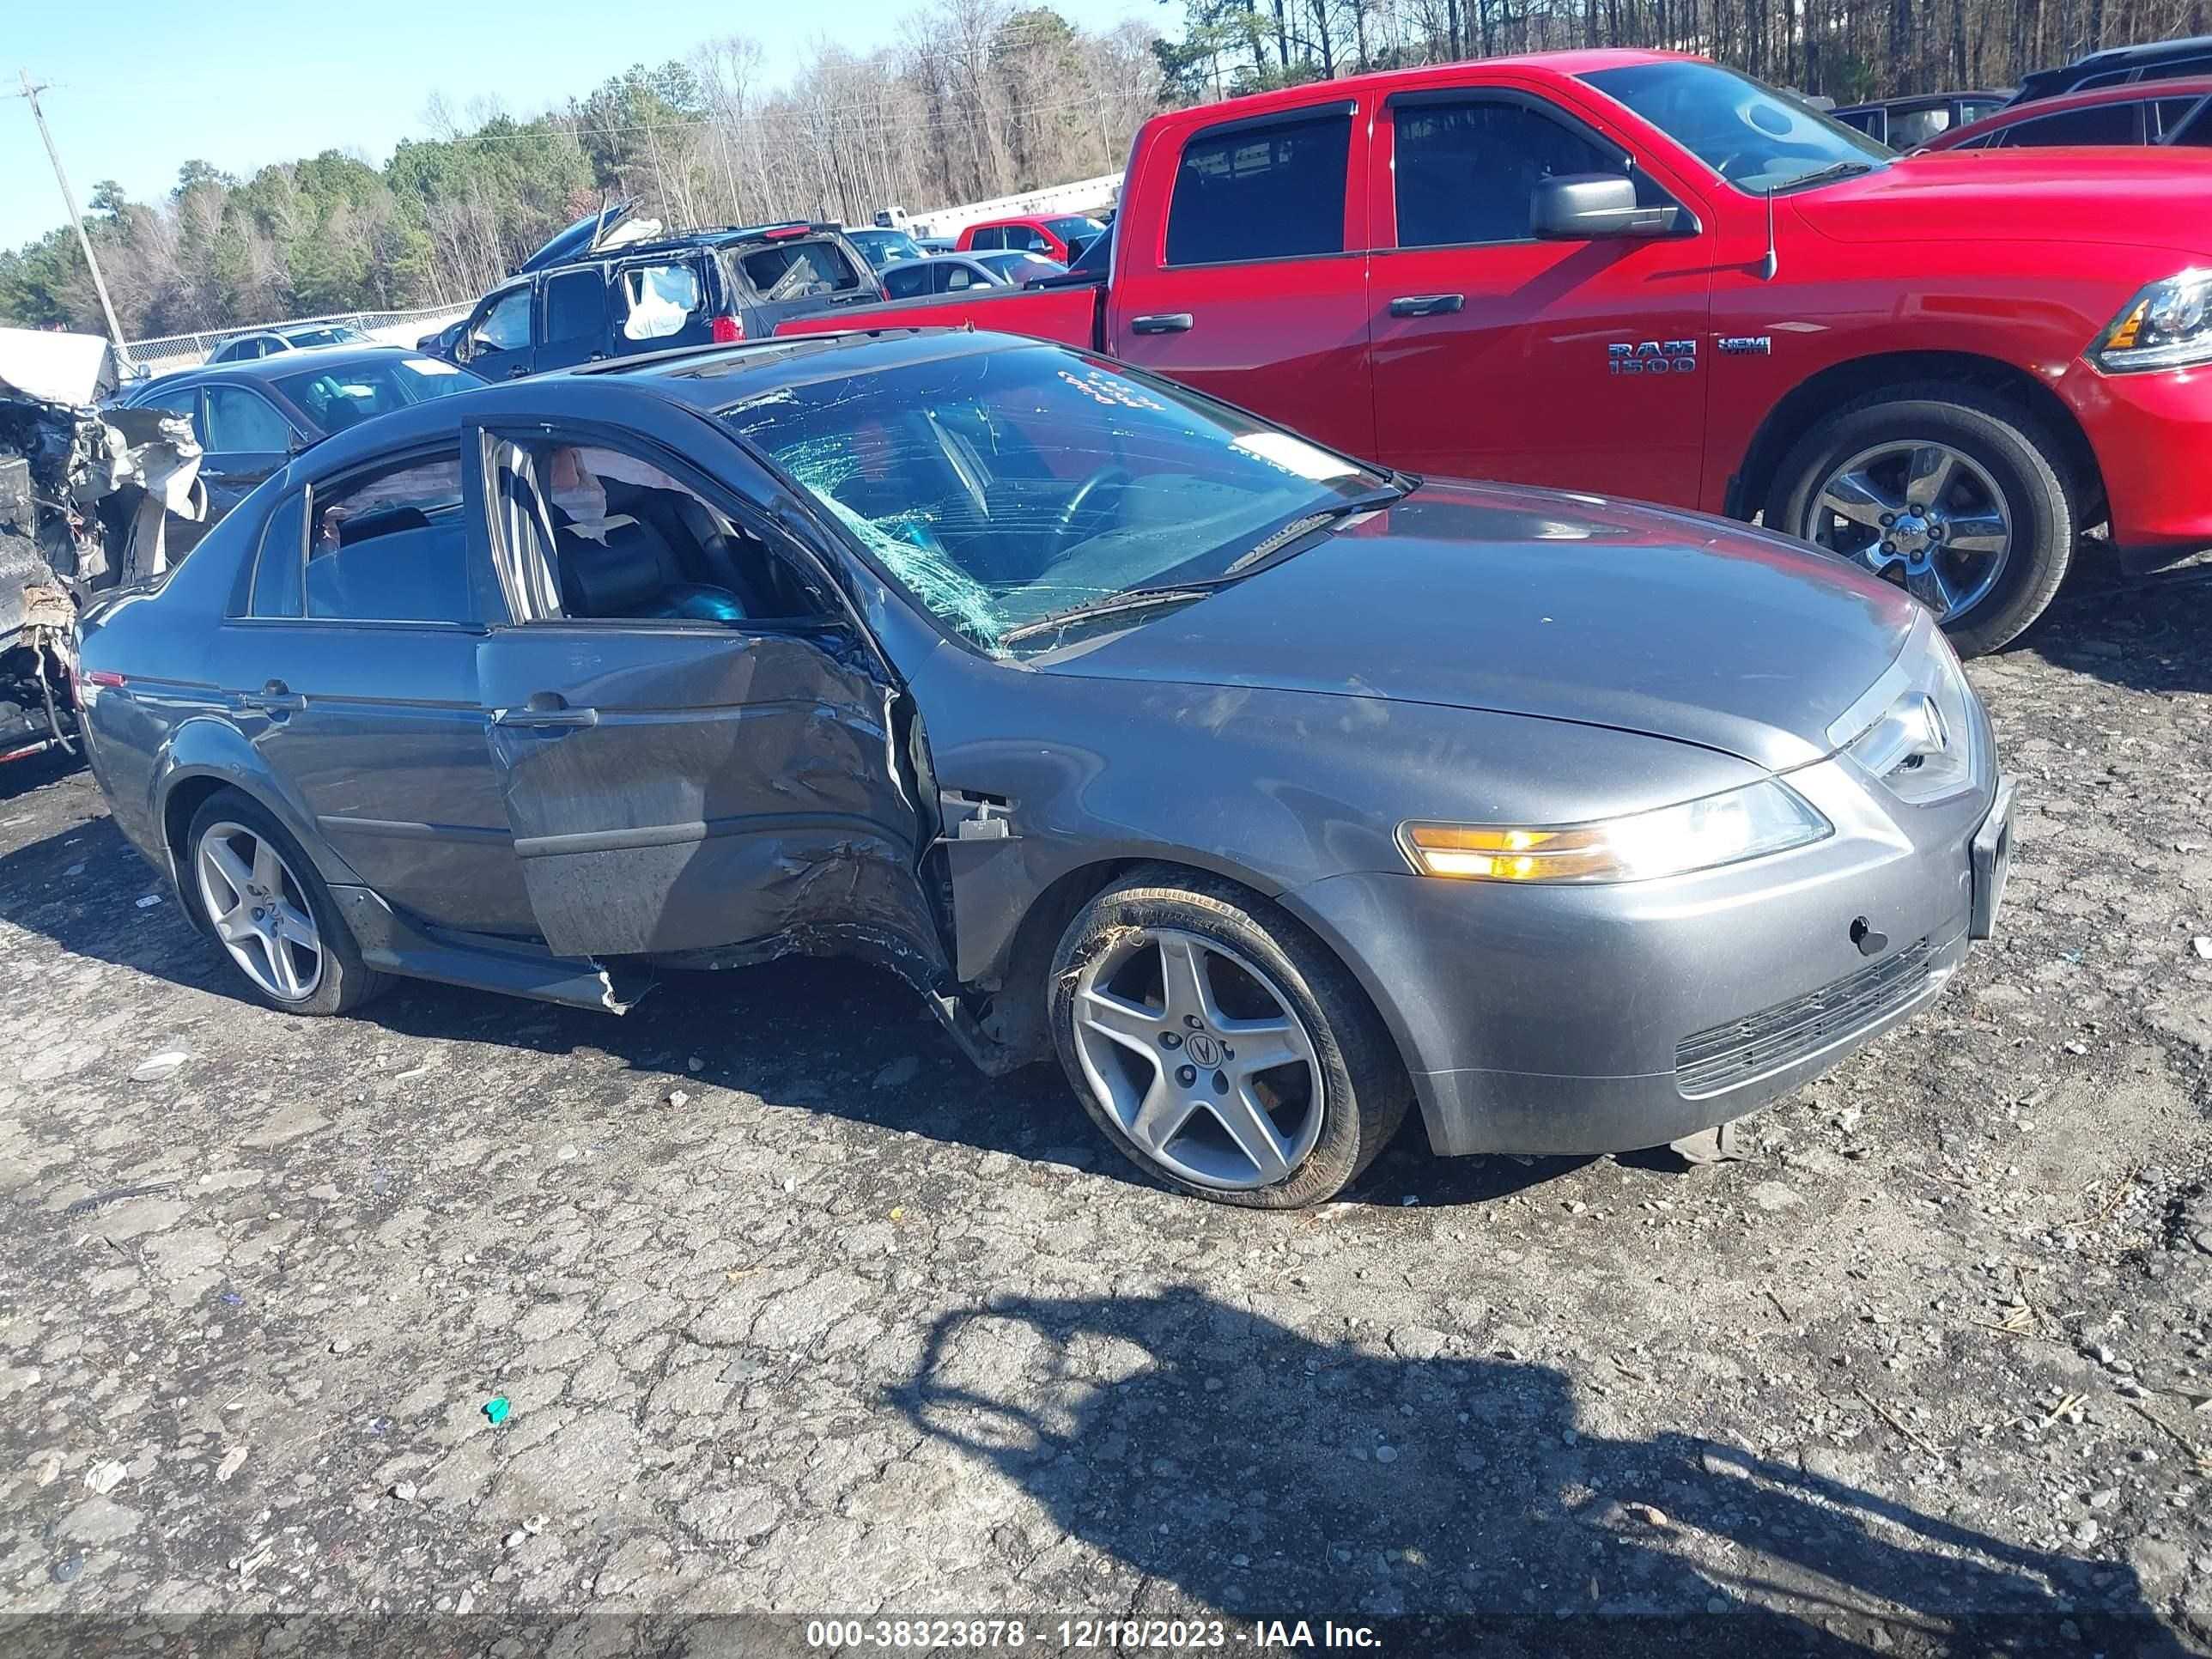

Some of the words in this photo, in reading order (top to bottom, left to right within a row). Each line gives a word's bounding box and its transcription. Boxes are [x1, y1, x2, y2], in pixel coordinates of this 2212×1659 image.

[1607, 340, 1697, 358] RAM
[1717, 336, 1771, 356] HEMI
[1607, 356, 1696, 374] 1500
